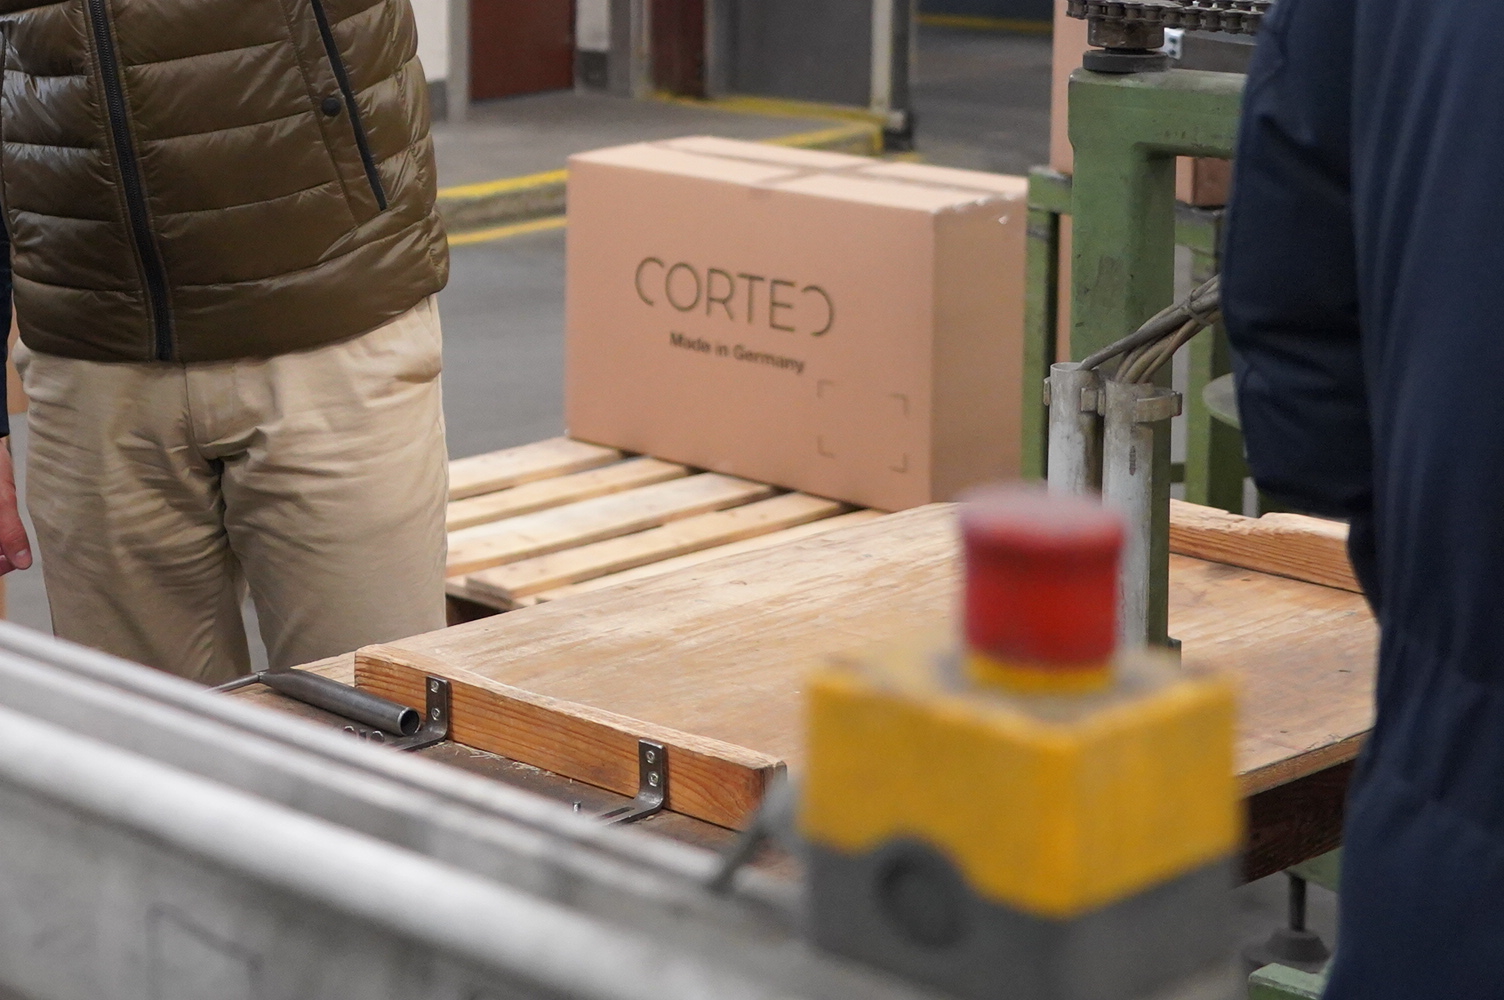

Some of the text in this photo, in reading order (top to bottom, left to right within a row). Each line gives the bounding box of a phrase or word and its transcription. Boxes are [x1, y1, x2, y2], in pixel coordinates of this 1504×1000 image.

[635, 258, 835, 337] CORTEC
[670, 331, 805, 374] Made in Germany
